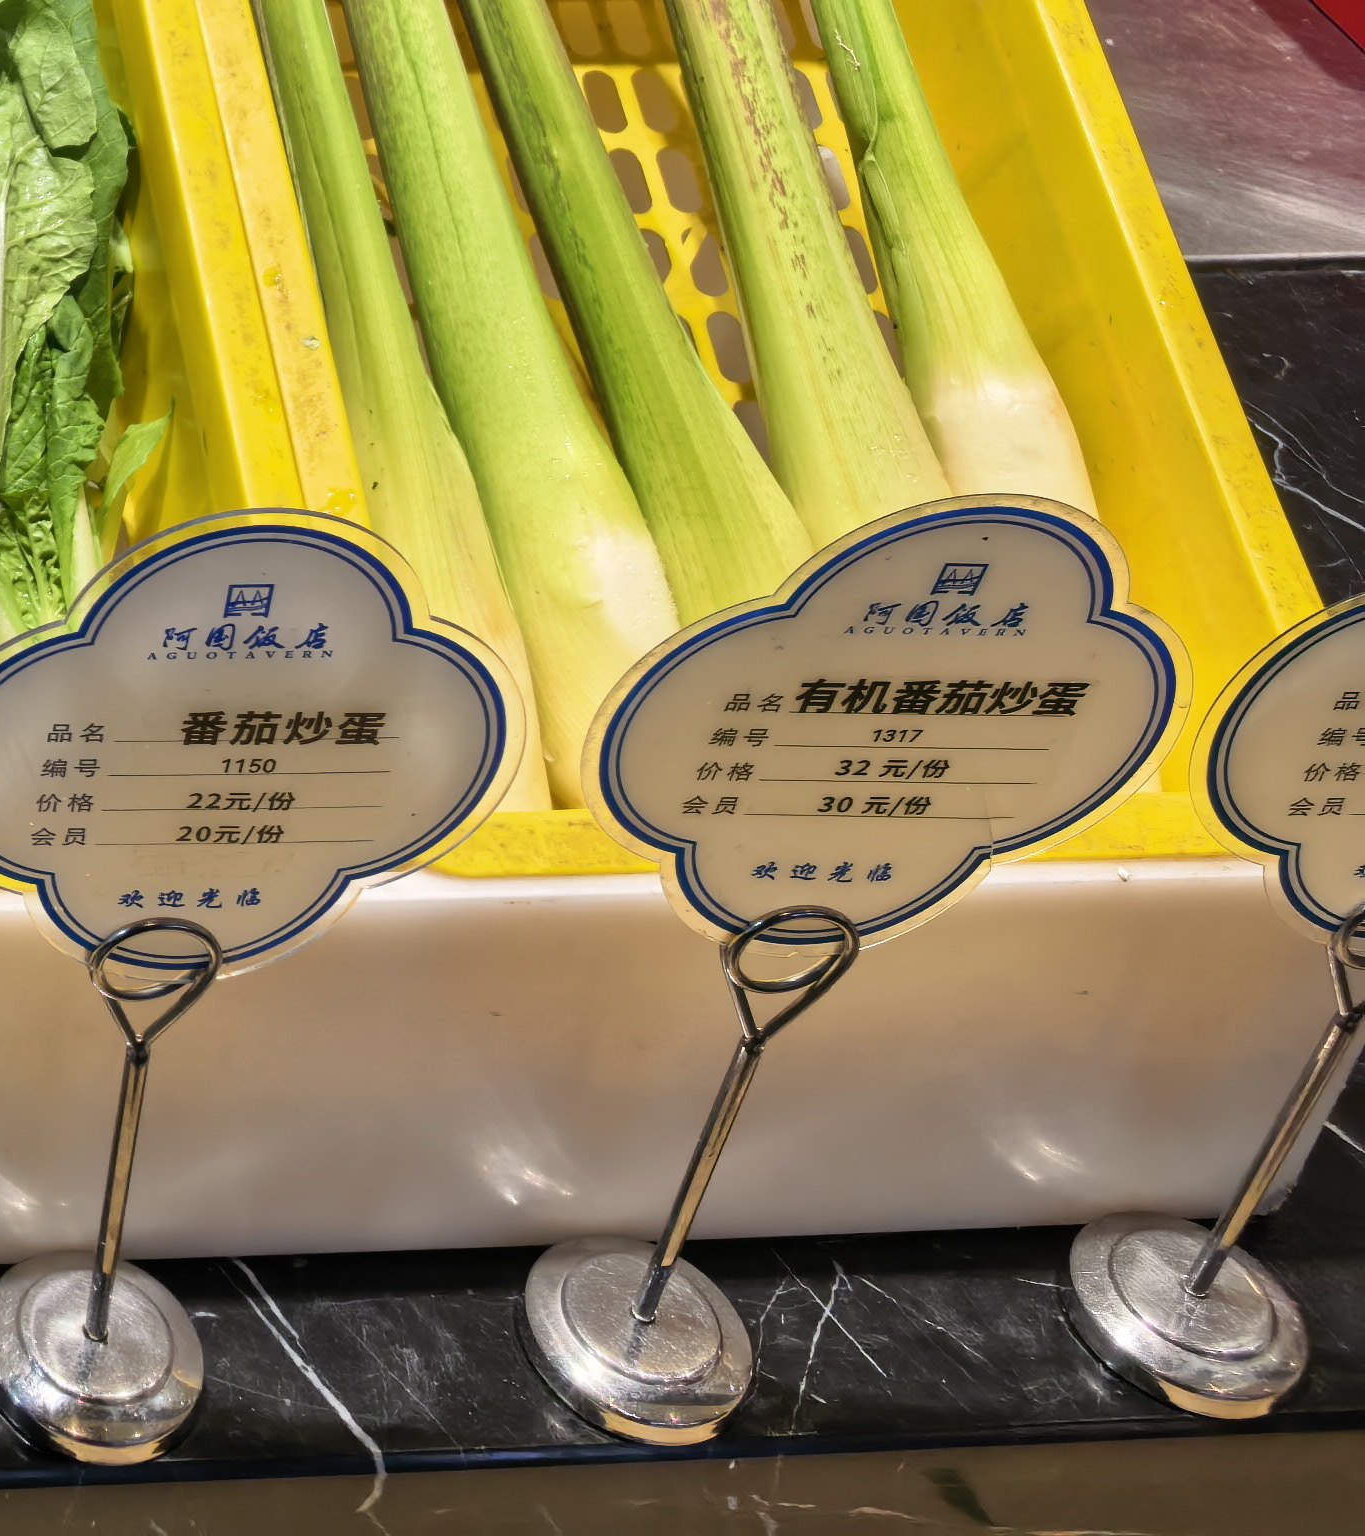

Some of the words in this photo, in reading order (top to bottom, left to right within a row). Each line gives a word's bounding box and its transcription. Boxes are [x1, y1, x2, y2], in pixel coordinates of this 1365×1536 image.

[723, 693, 783, 713] 品名
[795, 679, 1090, 717] 有机番茄炒蛋
[1333, 691, 1361, 711] 品
[46, 722, 106, 744] 品名
[180, 710, 387, 747] 番茄炒蛋
[709, 727, 770, 747] 编号
[872, 729, 924, 744] 1317
[40, 758, 101, 779] 编号
[221, 758, 277, 775] 1150
[695, 762, 755, 782] 价格
[1303, 762, 1361, 783] 价格
[35, 792, 96, 814] 价格
[186, 790, 296, 812] 22元/份
[681, 795, 740, 815] 会员
[1287, 796, 1346, 817] 会员
[30, 826, 88, 846] 会员
[175, 823, 285, 845] 20元/份
[751, 861, 894, 883] 欢迎光临
[117, 889, 262, 910] 欢迎光临
